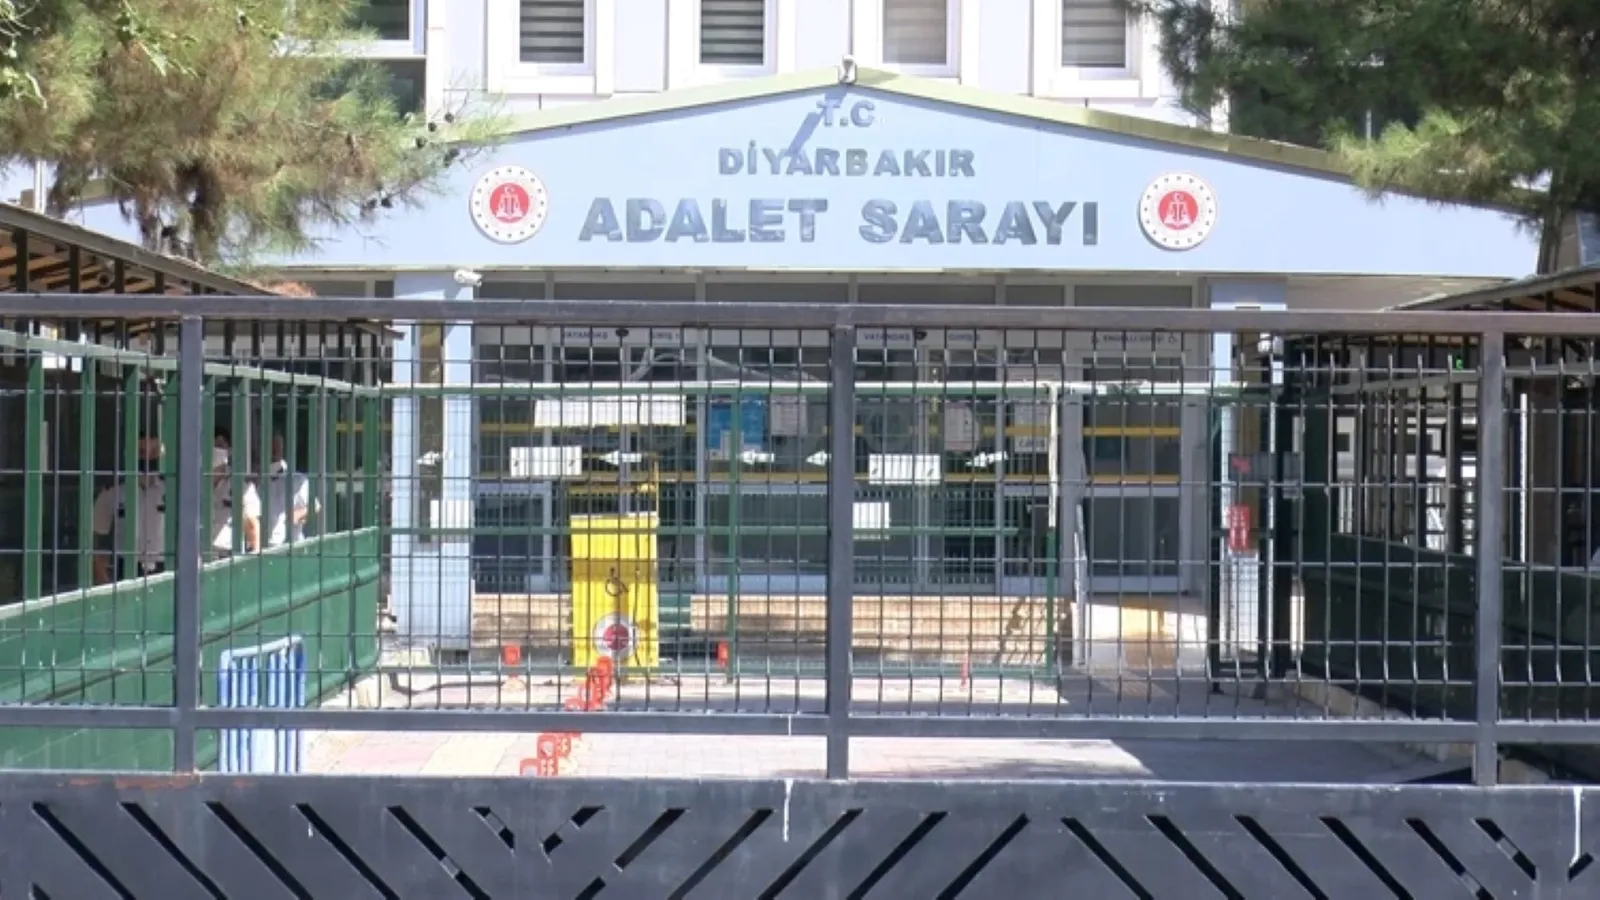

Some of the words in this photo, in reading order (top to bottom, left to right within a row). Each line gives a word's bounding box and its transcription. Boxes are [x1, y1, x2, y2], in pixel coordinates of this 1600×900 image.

[816, 98, 876, 128] T.C
[718, 140, 976, 177] DİYARBAKIR
[578, 197, 828, 243] ADALET
[858, 199, 1099, 246] SARAYI
